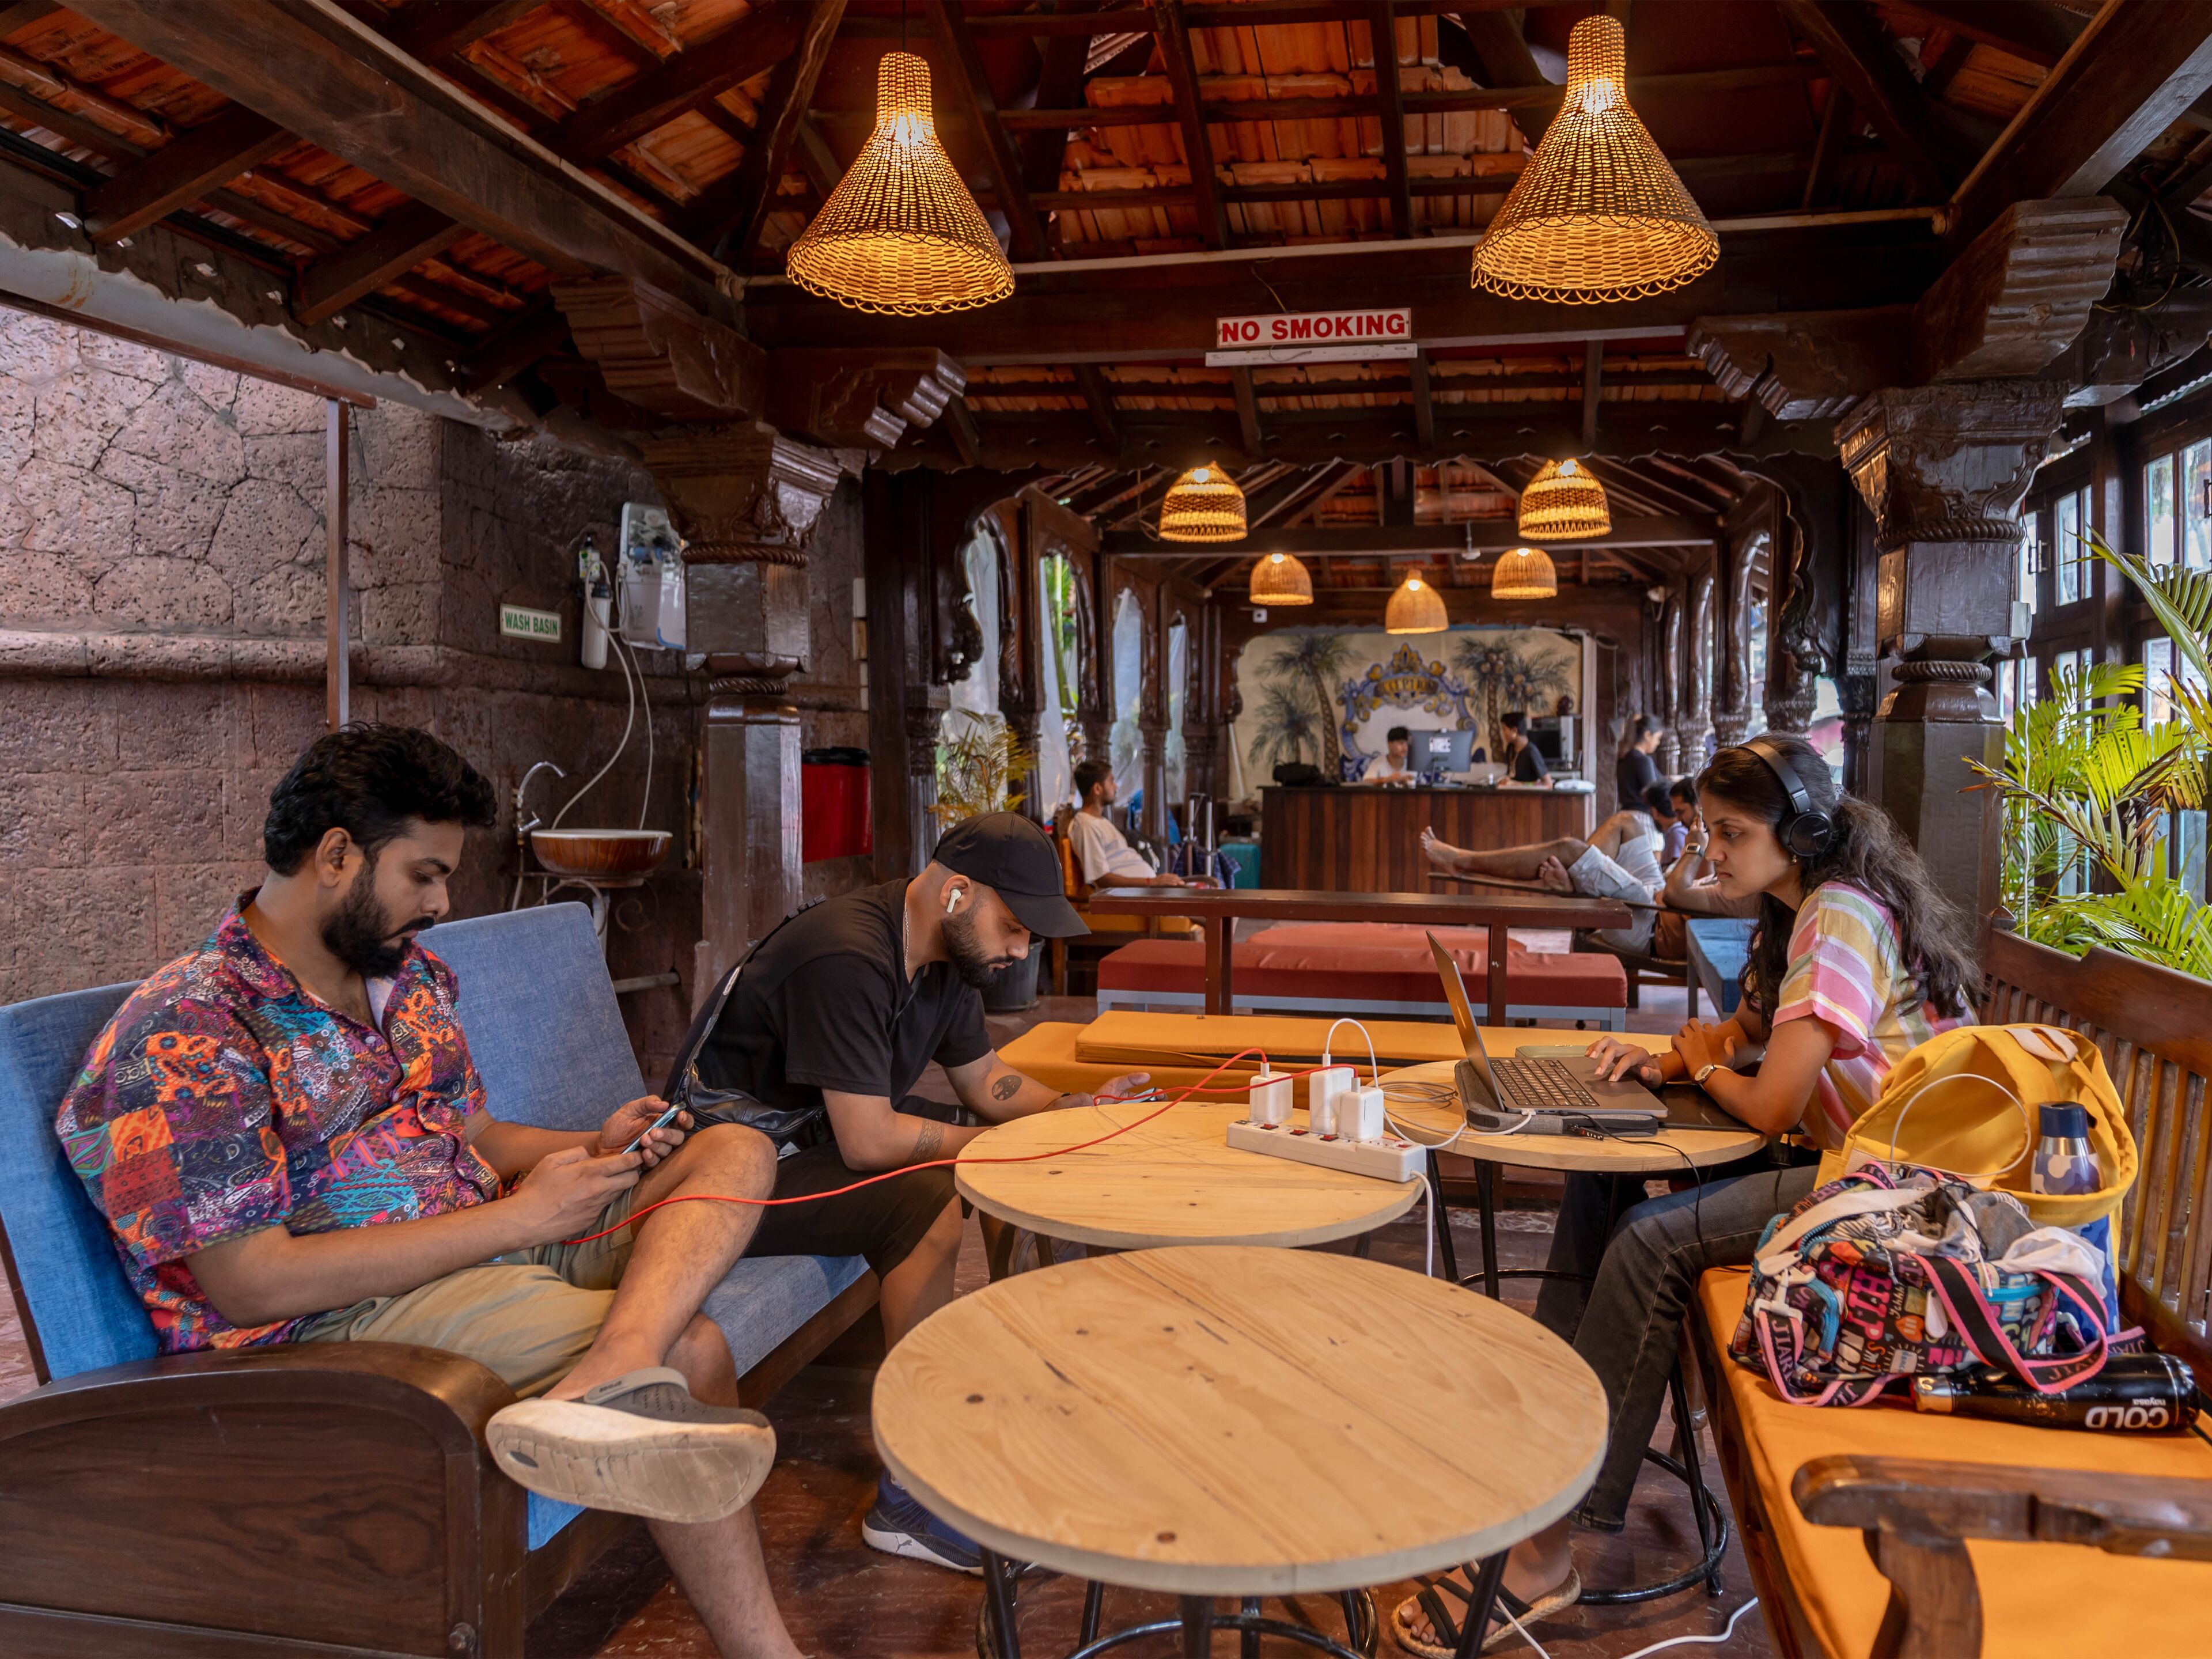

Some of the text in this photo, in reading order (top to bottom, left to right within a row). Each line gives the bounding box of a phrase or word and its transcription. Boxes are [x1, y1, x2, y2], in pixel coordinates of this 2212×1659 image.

[1222, 313, 1405, 342] NO SMOKING
[505, 612, 558, 635] WASH BASIN
[1835, 1328, 1865, 1373] FUN
[2132, 1396, 2166, 1406] nayasa
[2084, 1406, 2169, 1429] COLD
